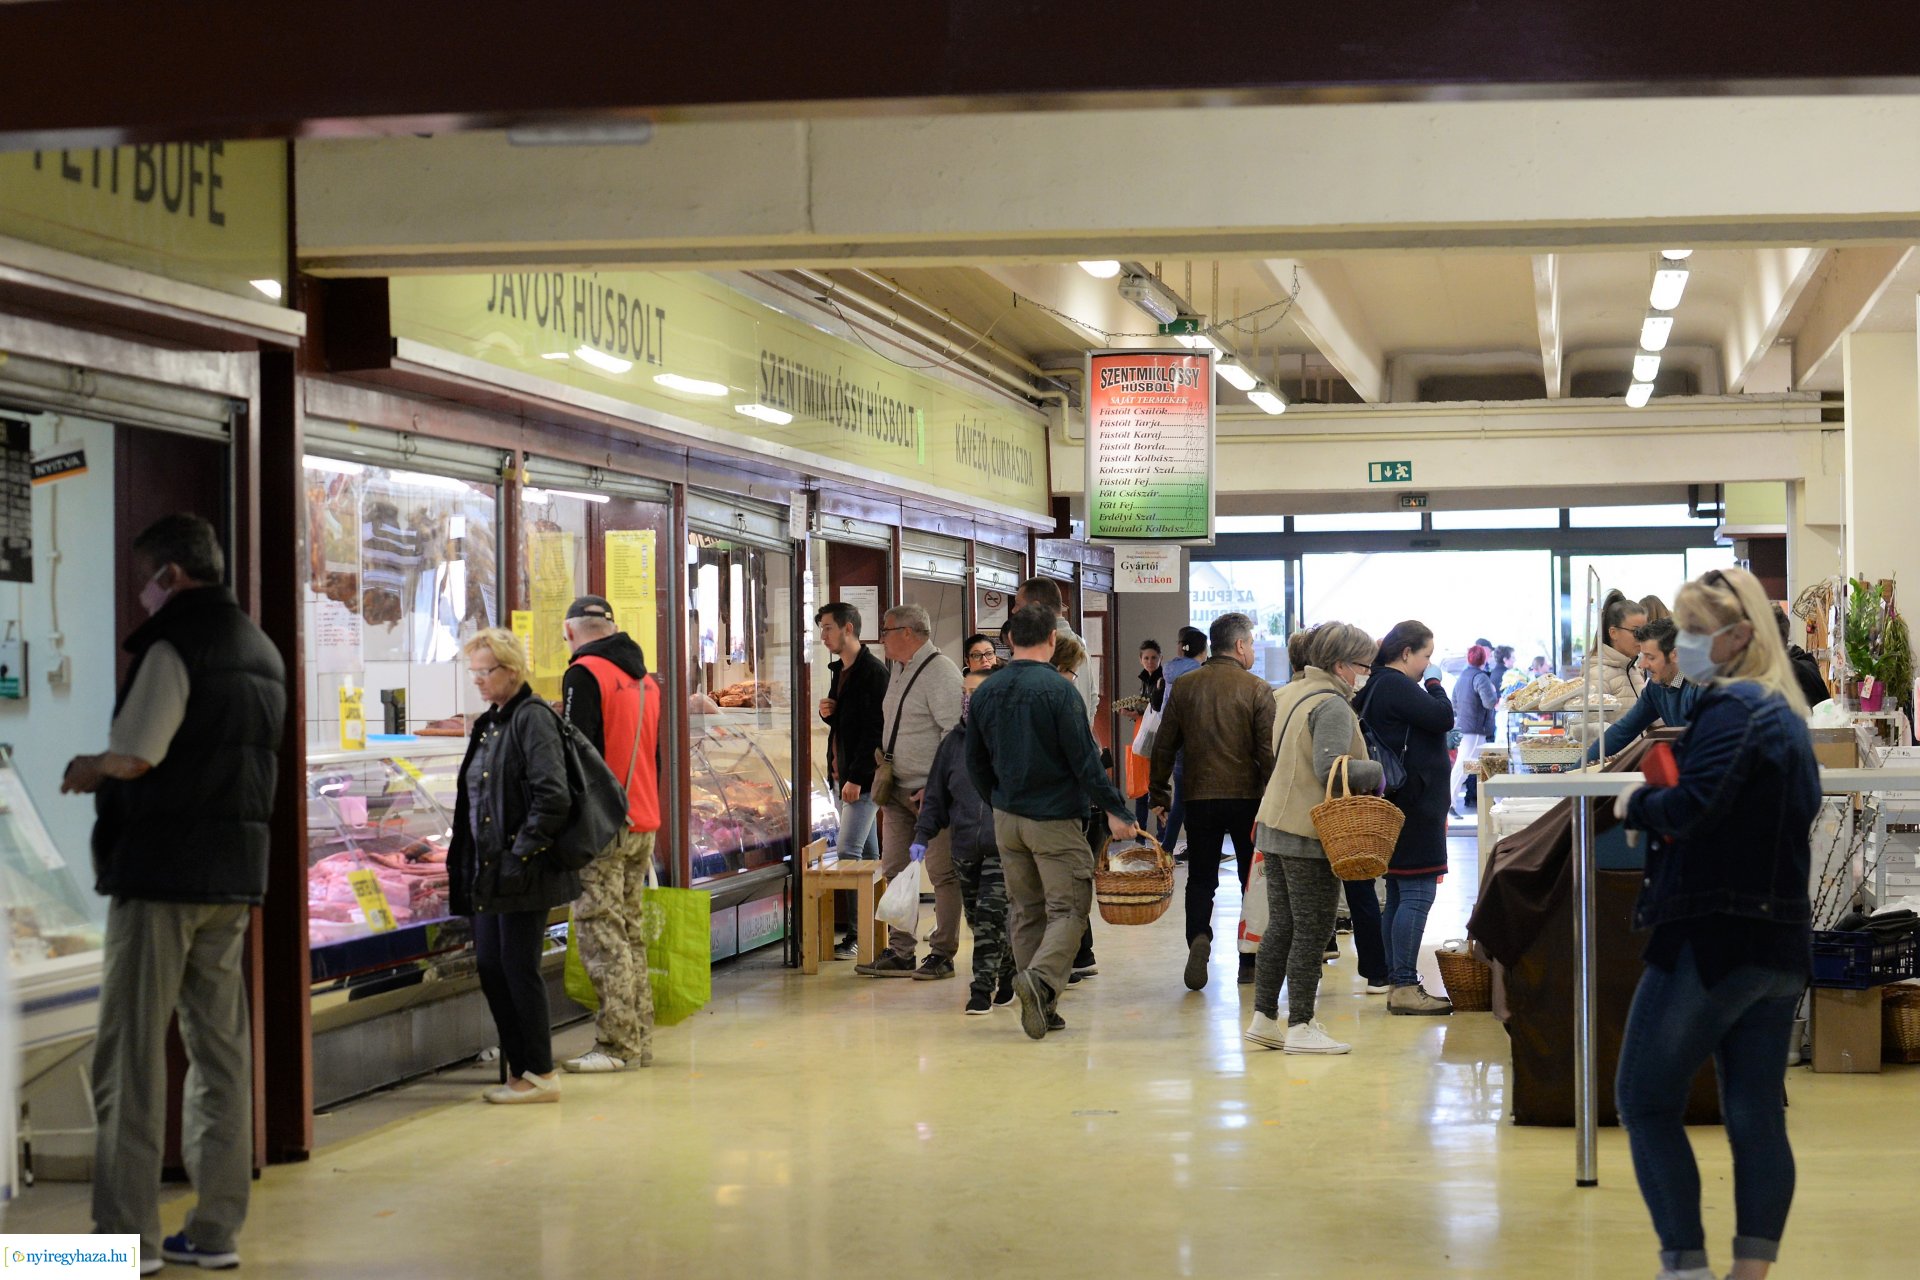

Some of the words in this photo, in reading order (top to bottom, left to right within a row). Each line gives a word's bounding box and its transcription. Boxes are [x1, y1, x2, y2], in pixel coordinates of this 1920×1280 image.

[573, 272, 666, 367] HÚSBOLT
[1100, 363, 1200, 390] SZENTMIKLÓSSY
[1121, 381, 1176, 393] HÚSBOLT
[760, 349, 864, 434] SZENTMIKLÓSSY
[866, 381, 915, 449] HÚSBOLT
[1137, 395, 1188, 405] TERMÉKEK
[1099, 407, 1131, 416] Füstölt
[1133, 407, 1168, 415] Csülök
[1099, 419, 1131, 427] Füstölt
[1134, 419, 1161, 429] Tarja
[1099, 431, 1131, 439] Füstölt
[1133, 431, 1162, 441] Karaj
[955, 413, 991, 483] KÁVÉZÓ,
[991, 433, 1034, 487] CUKRÁSZDA
[1099, 443, 1131, 451] Füstölt
[1133, 443, 1166, 451] Borda
[1099, 454, 1131, 463] Füstölt
[1133, 454, 1175, 463] Kolbász
[34, 455, 81, 477] NYITVA
[1099, 466, 1151, 474] Kolozsvári
[1099, 478, 1131, 486] Füstölt
[1134, 478, 1150, 488] Fej
[1119, 489, 1160, 498] Császár
[1119, 501, 1135, 511] Fej
[1402, 497, 1426, 506] EXIT
[1099, 513, 1133, 522] Erdélyi
[1145, 525, 1186, 533] Kolbász
[1120, 561, 1159, 573] Gyártói
